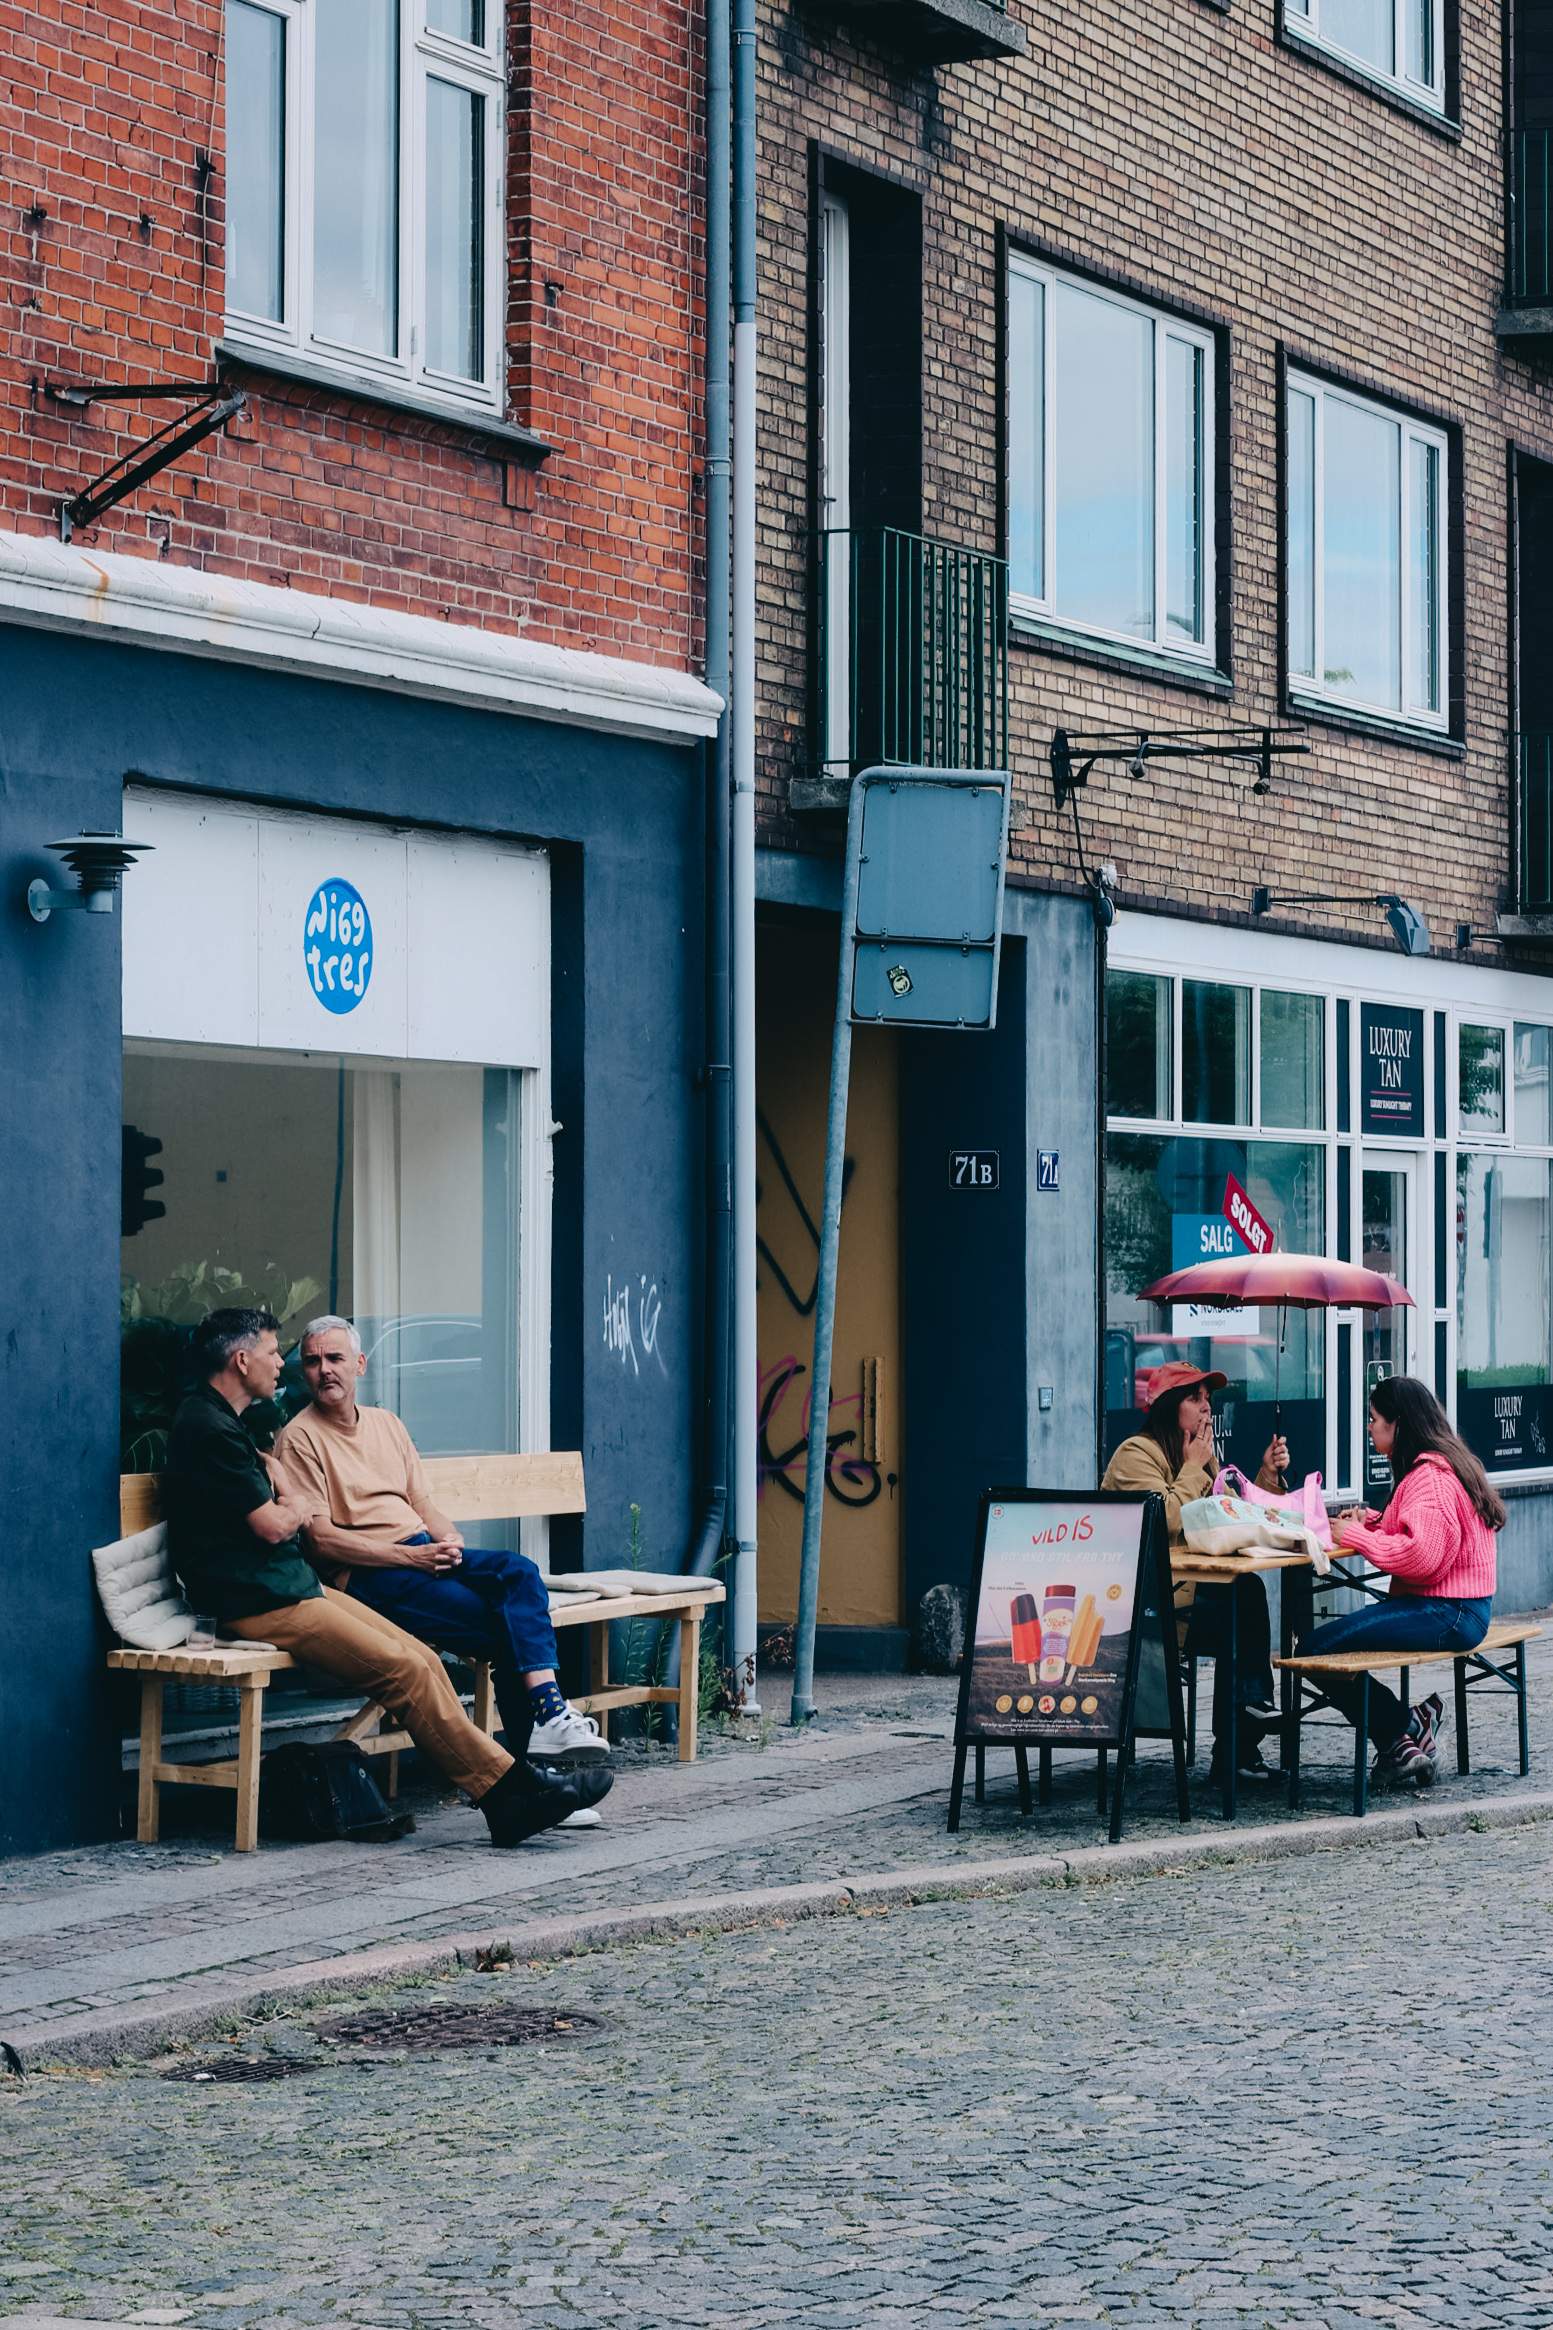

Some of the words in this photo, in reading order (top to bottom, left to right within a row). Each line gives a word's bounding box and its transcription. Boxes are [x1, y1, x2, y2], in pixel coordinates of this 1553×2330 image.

[1369, 1026, 1412, 1058] LUXURY
[1379, 1058, 1402, 1088] TAN
[955, 1155, 993, 1184] 71B
[1230, 1192, 1268, 1254] SOLGT
[1200, 1224, 1233, 1253] SALG
[1494, 1395, 1523, 1418] LUXURY
[1500, 1418, 1516, 1440] TAN
[1031, 1523, 1068, 1545] VILD
[1071, 1514, 1094, 1541] IS
[1047, 1551, 1072, 1563] STIL
[1101, 1551, 1124, 1563] THY
